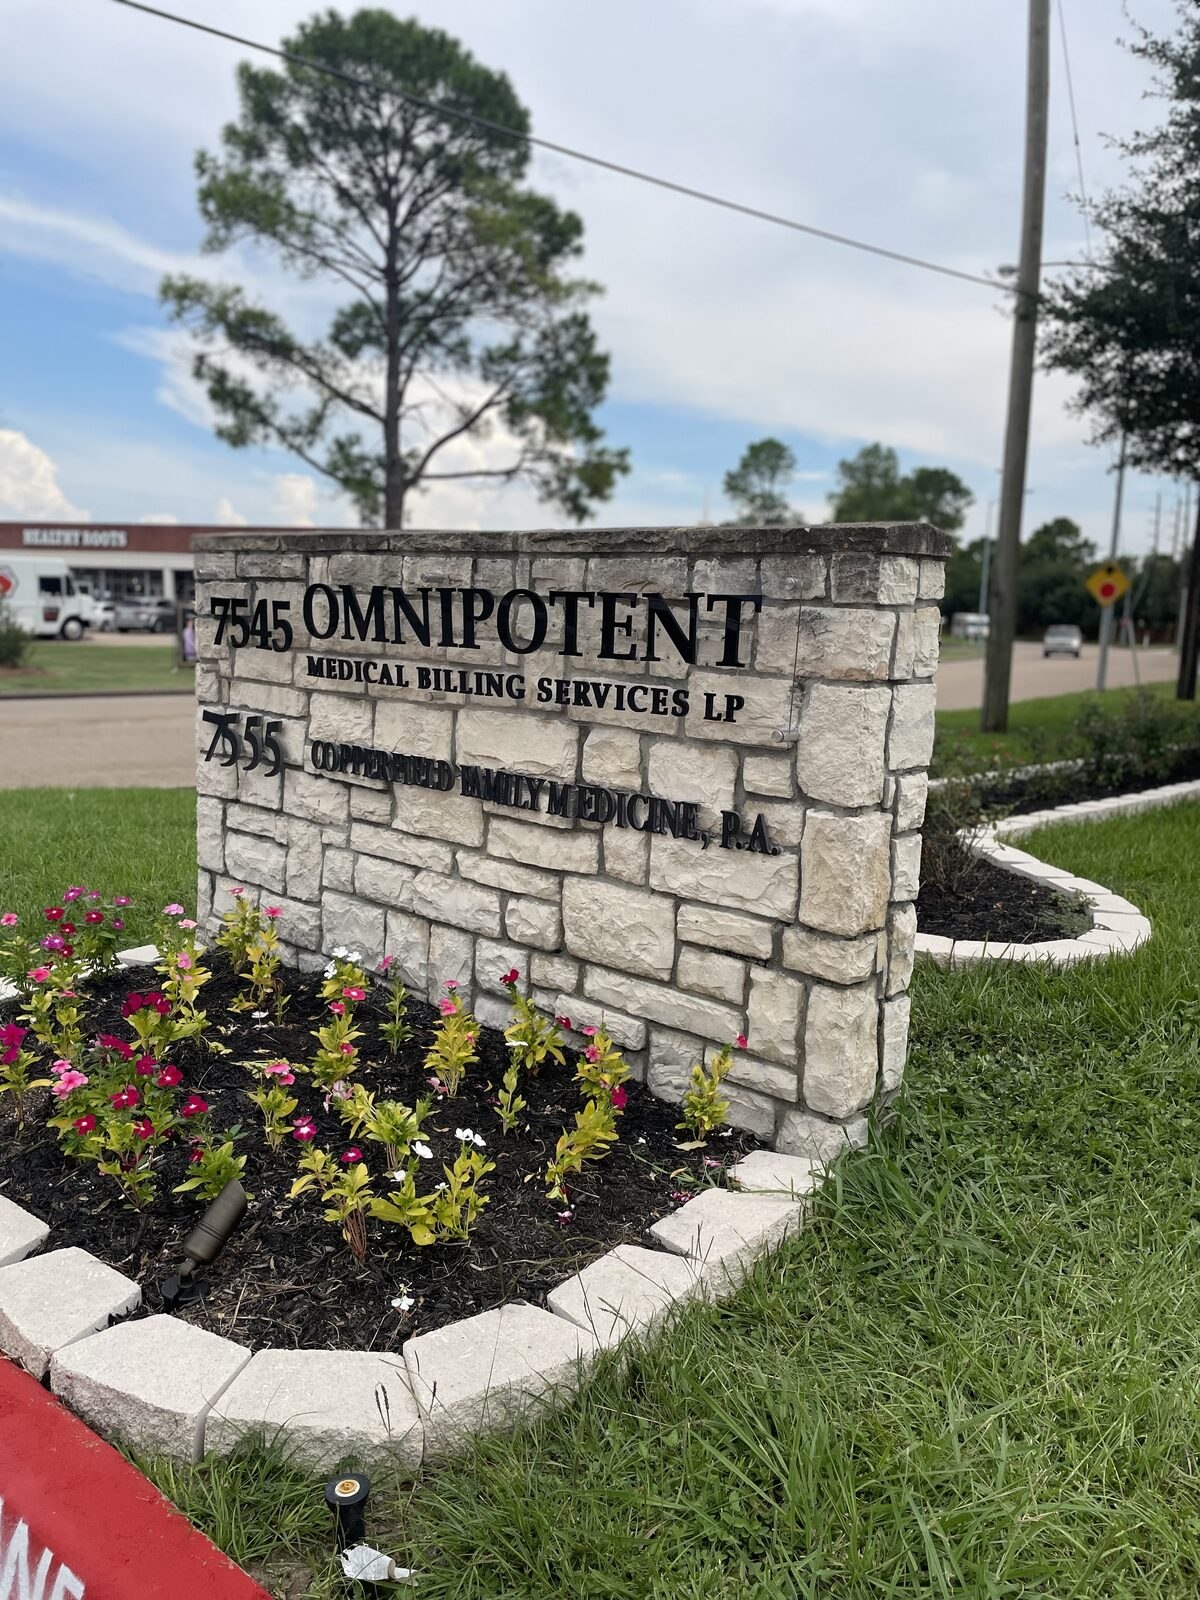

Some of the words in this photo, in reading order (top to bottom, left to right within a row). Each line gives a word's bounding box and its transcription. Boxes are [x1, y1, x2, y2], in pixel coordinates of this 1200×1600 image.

[210, 597, 293, 652] 7545
[303, 583, 762, 668] OMNIPOTENT
[307, 656, 409, 687] MEDICAL
[416, 667, 526, 700] BILLING
[537, 678, 690, 717] SERVICES
[703, 693, 745, 723] LP
[202, 709, 283, 777] 7555
[719, 810, 784, 856] P.A.
